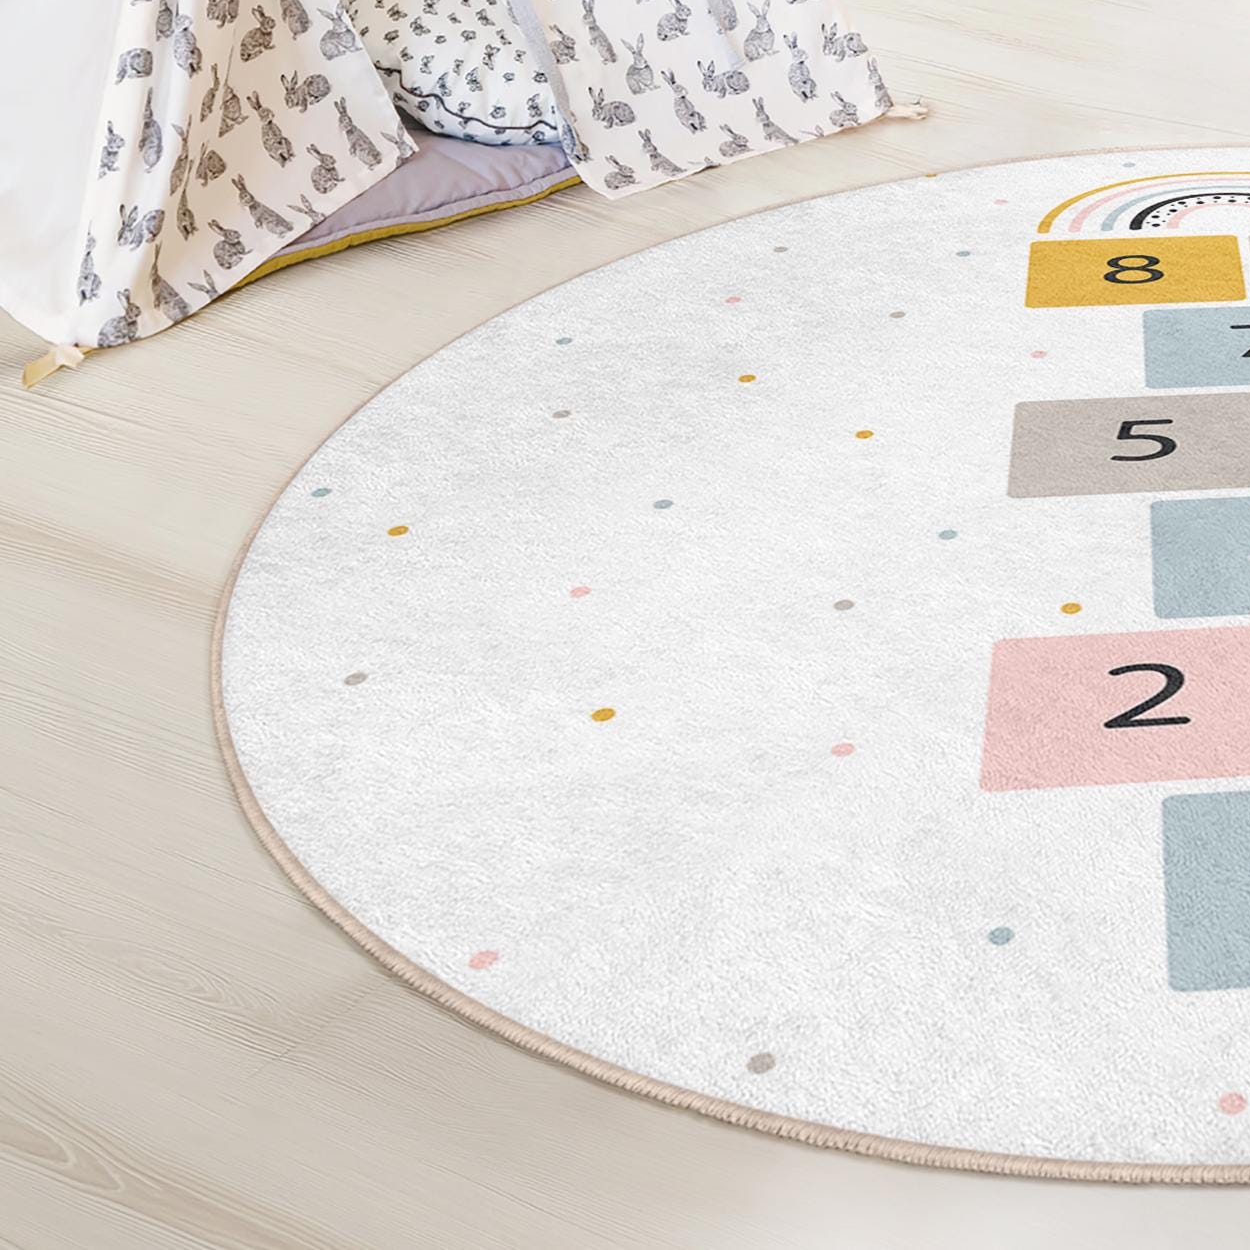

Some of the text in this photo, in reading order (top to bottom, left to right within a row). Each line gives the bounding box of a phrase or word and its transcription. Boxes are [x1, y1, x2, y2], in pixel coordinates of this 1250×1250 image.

[1104, 255, 1164, 284] 8
[1111, 419, 1177, 462] 5
[1104, 663, 1191, 729] 2
